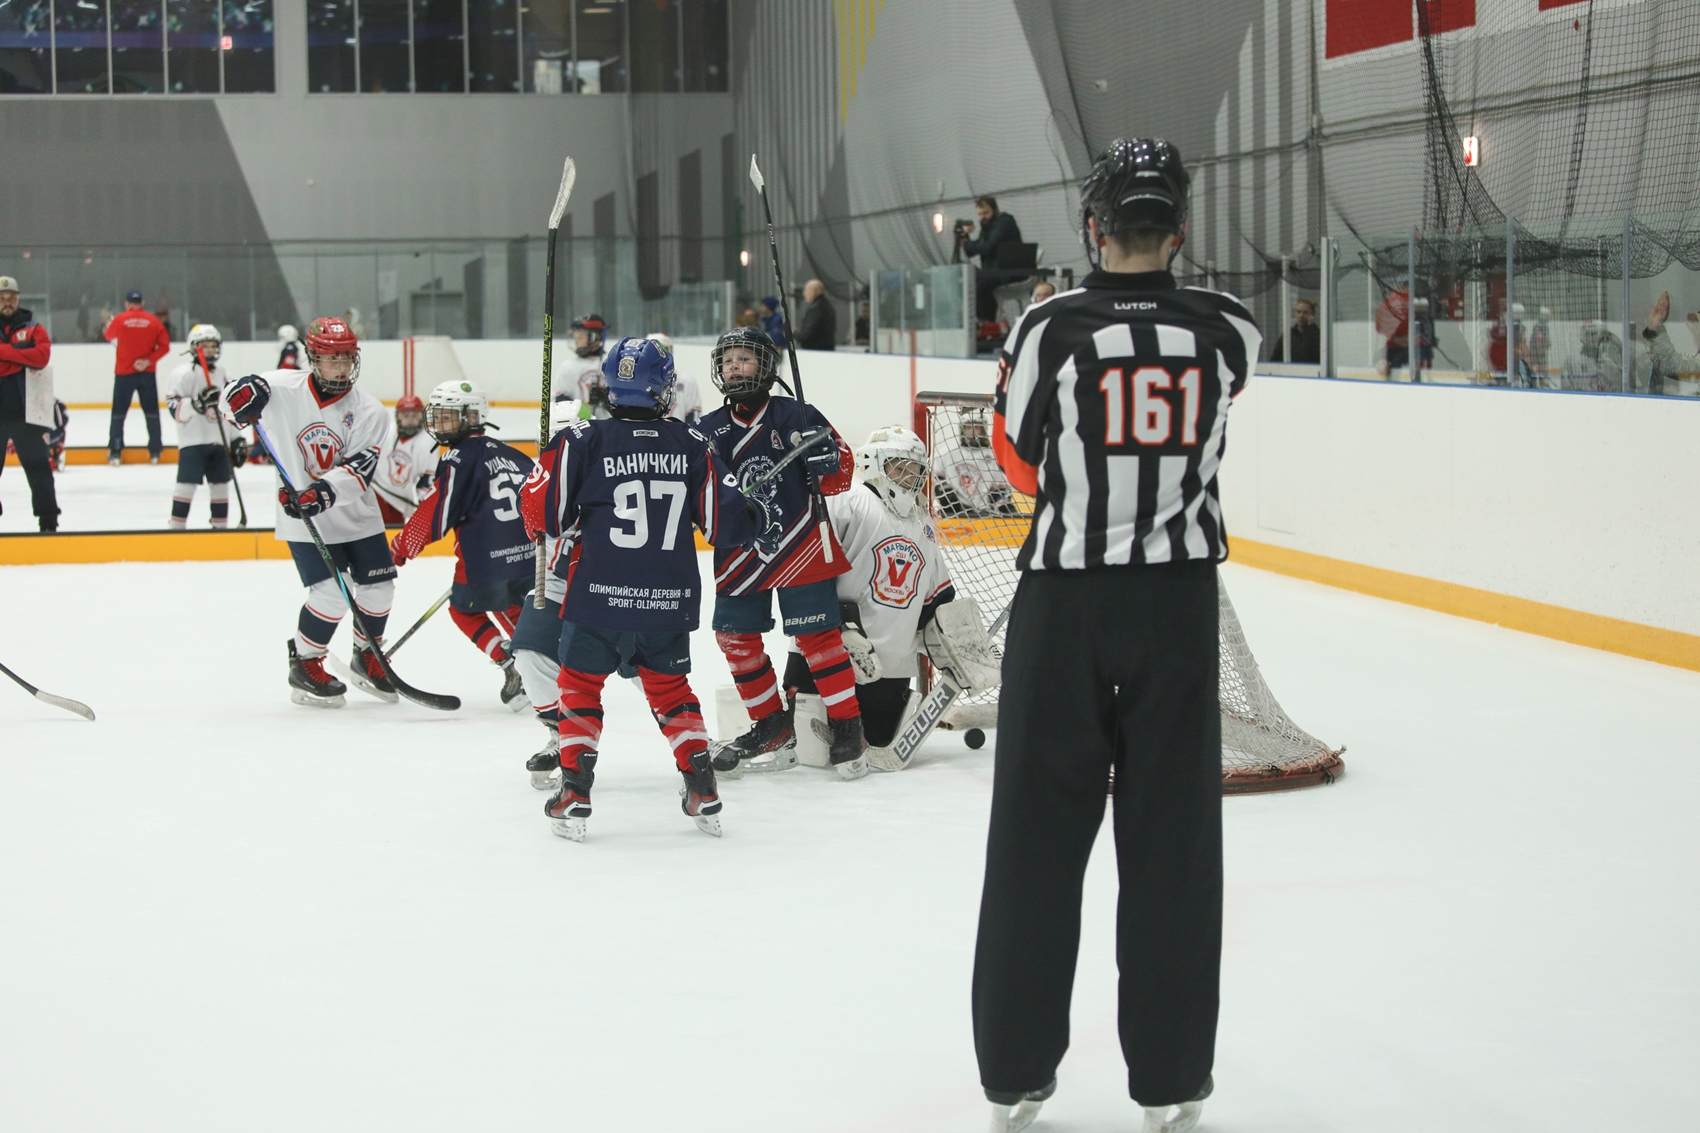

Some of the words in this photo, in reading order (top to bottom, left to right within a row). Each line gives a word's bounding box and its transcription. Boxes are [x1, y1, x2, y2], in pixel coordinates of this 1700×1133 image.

[1114, 302, 1158, 310] LUTCH
[540, 313, 552, 449] SHERWOOD
[1099, 366, 1202, 446] 161
[609, 479, 688, 551] 97
[589, 583, 650, 598] ОЛИМПИЙСКАЯ
[650, 588, 681, 600] ДЕРЕВНЯ
[608, 597, 679, 610] SPORT-OLIMP80.RU
[784, 613, 827, 627] BAUER
[895, 687, 950, 759] BAUER
